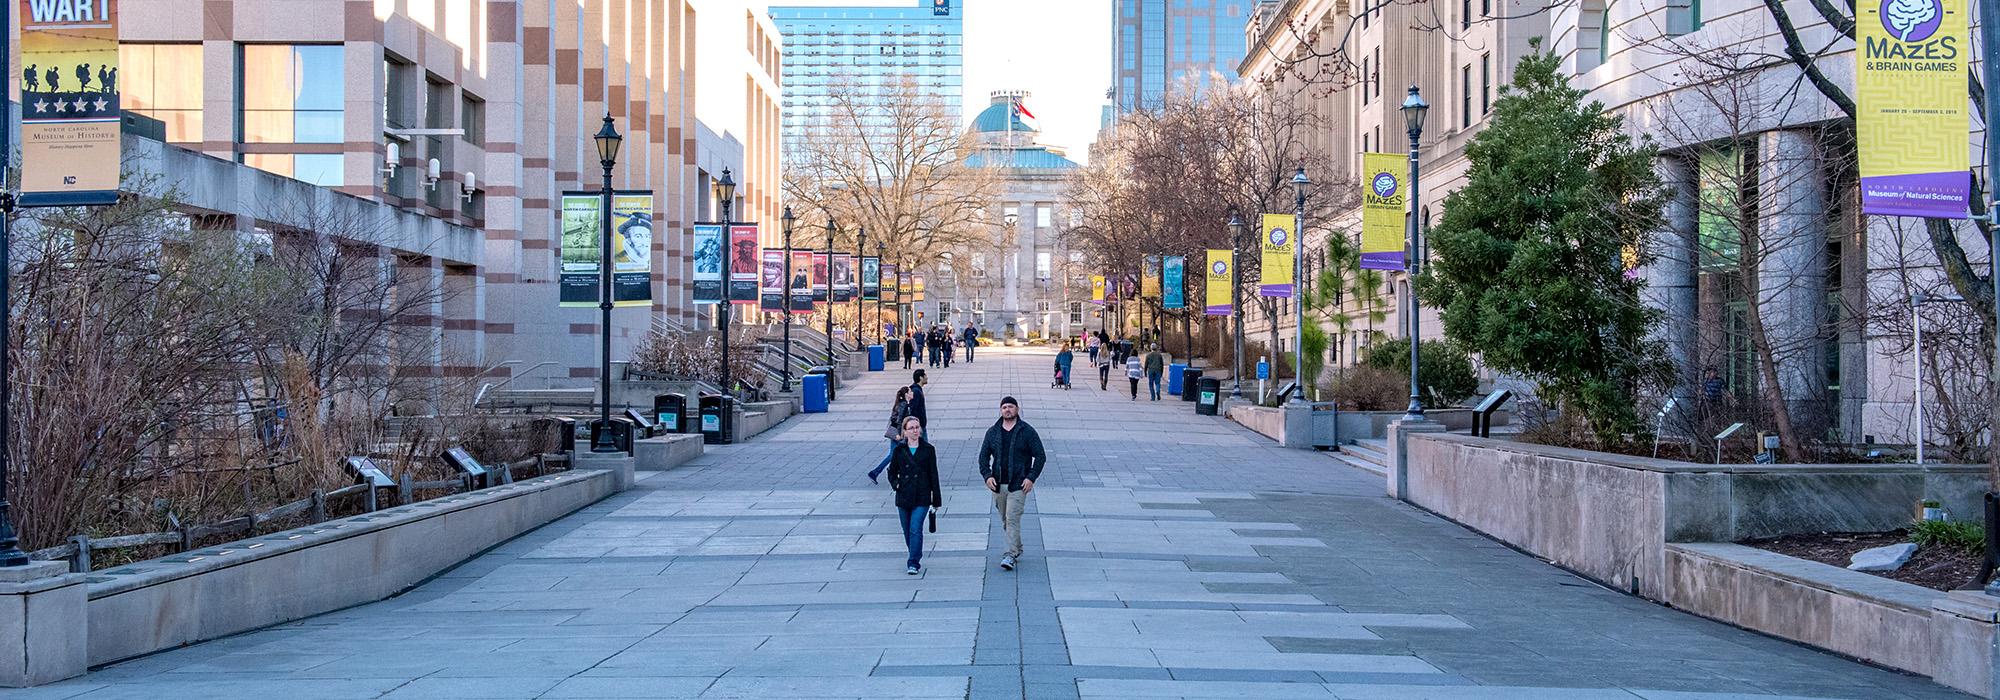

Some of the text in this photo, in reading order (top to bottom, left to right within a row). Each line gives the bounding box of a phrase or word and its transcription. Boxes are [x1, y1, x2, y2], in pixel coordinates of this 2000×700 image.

[30, 0, 93, 22] WAR
[1866, 36, 1957, 59] MAZES
[1866, 61, 1957, 71] & BRAIN GAMES
[63, 176, 76, 184] NC
[1367, 194, 1402, 206] MAZES
[1868, 190, 1963, 201] Museum of Natural Sciences
[1265, 243, 1291, 251] MAZES
